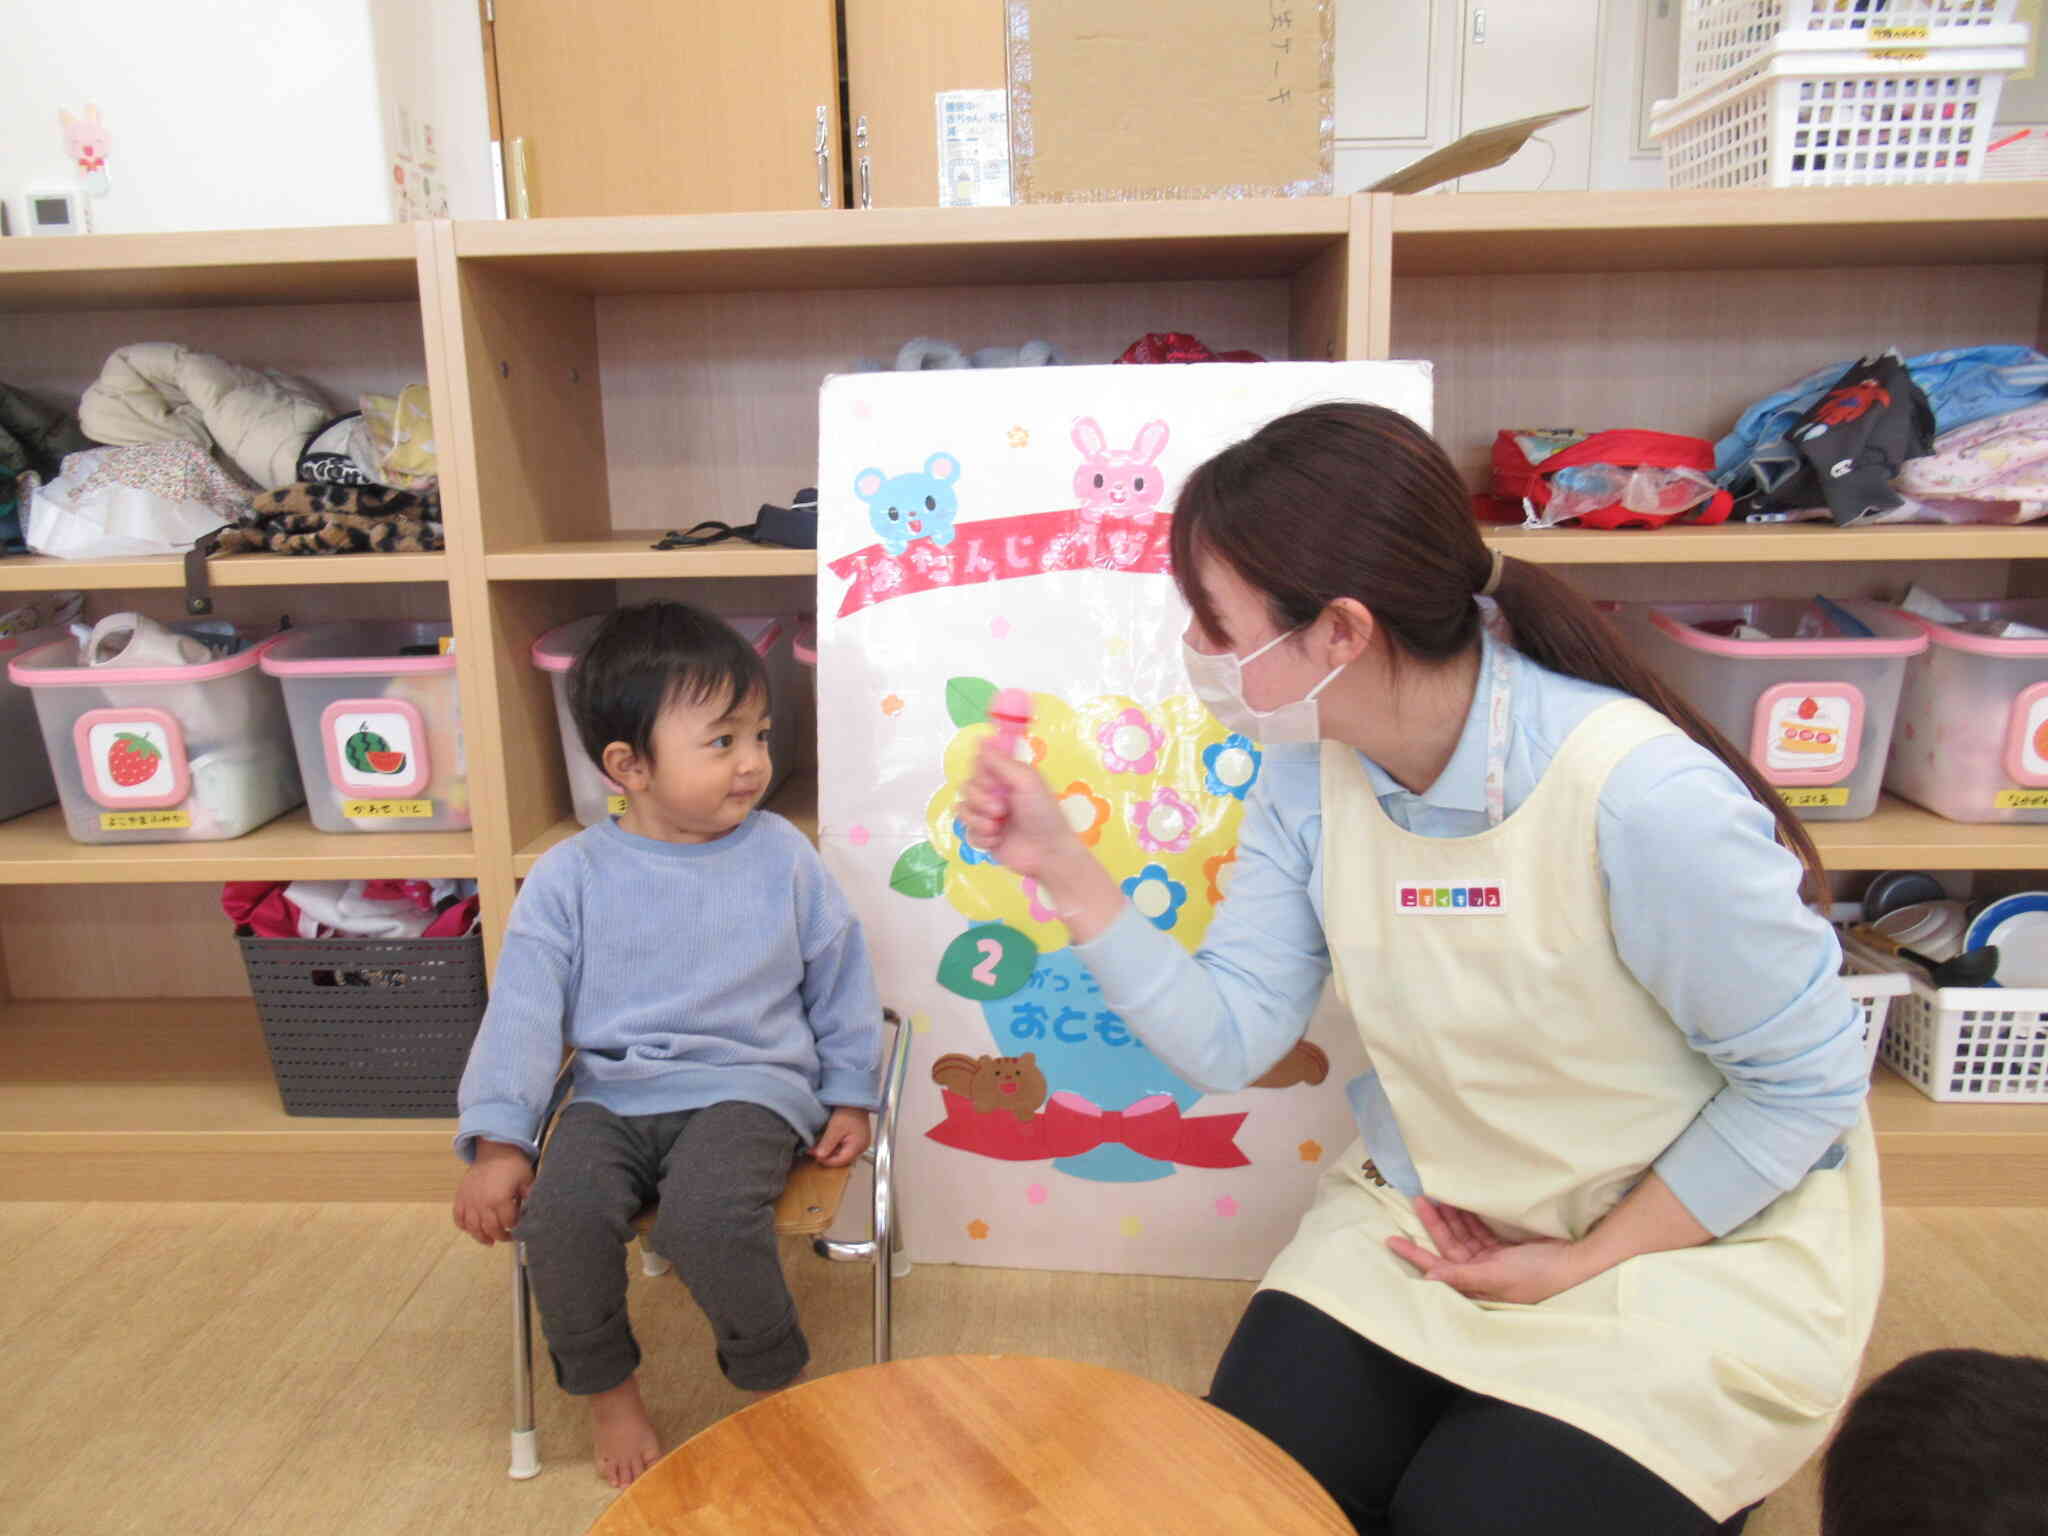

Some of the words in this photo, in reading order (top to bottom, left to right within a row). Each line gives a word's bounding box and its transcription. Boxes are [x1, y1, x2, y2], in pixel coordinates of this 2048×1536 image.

[971, 938, 1004, 988] 2
[1009, 1001, 1145, 1049] おとも
